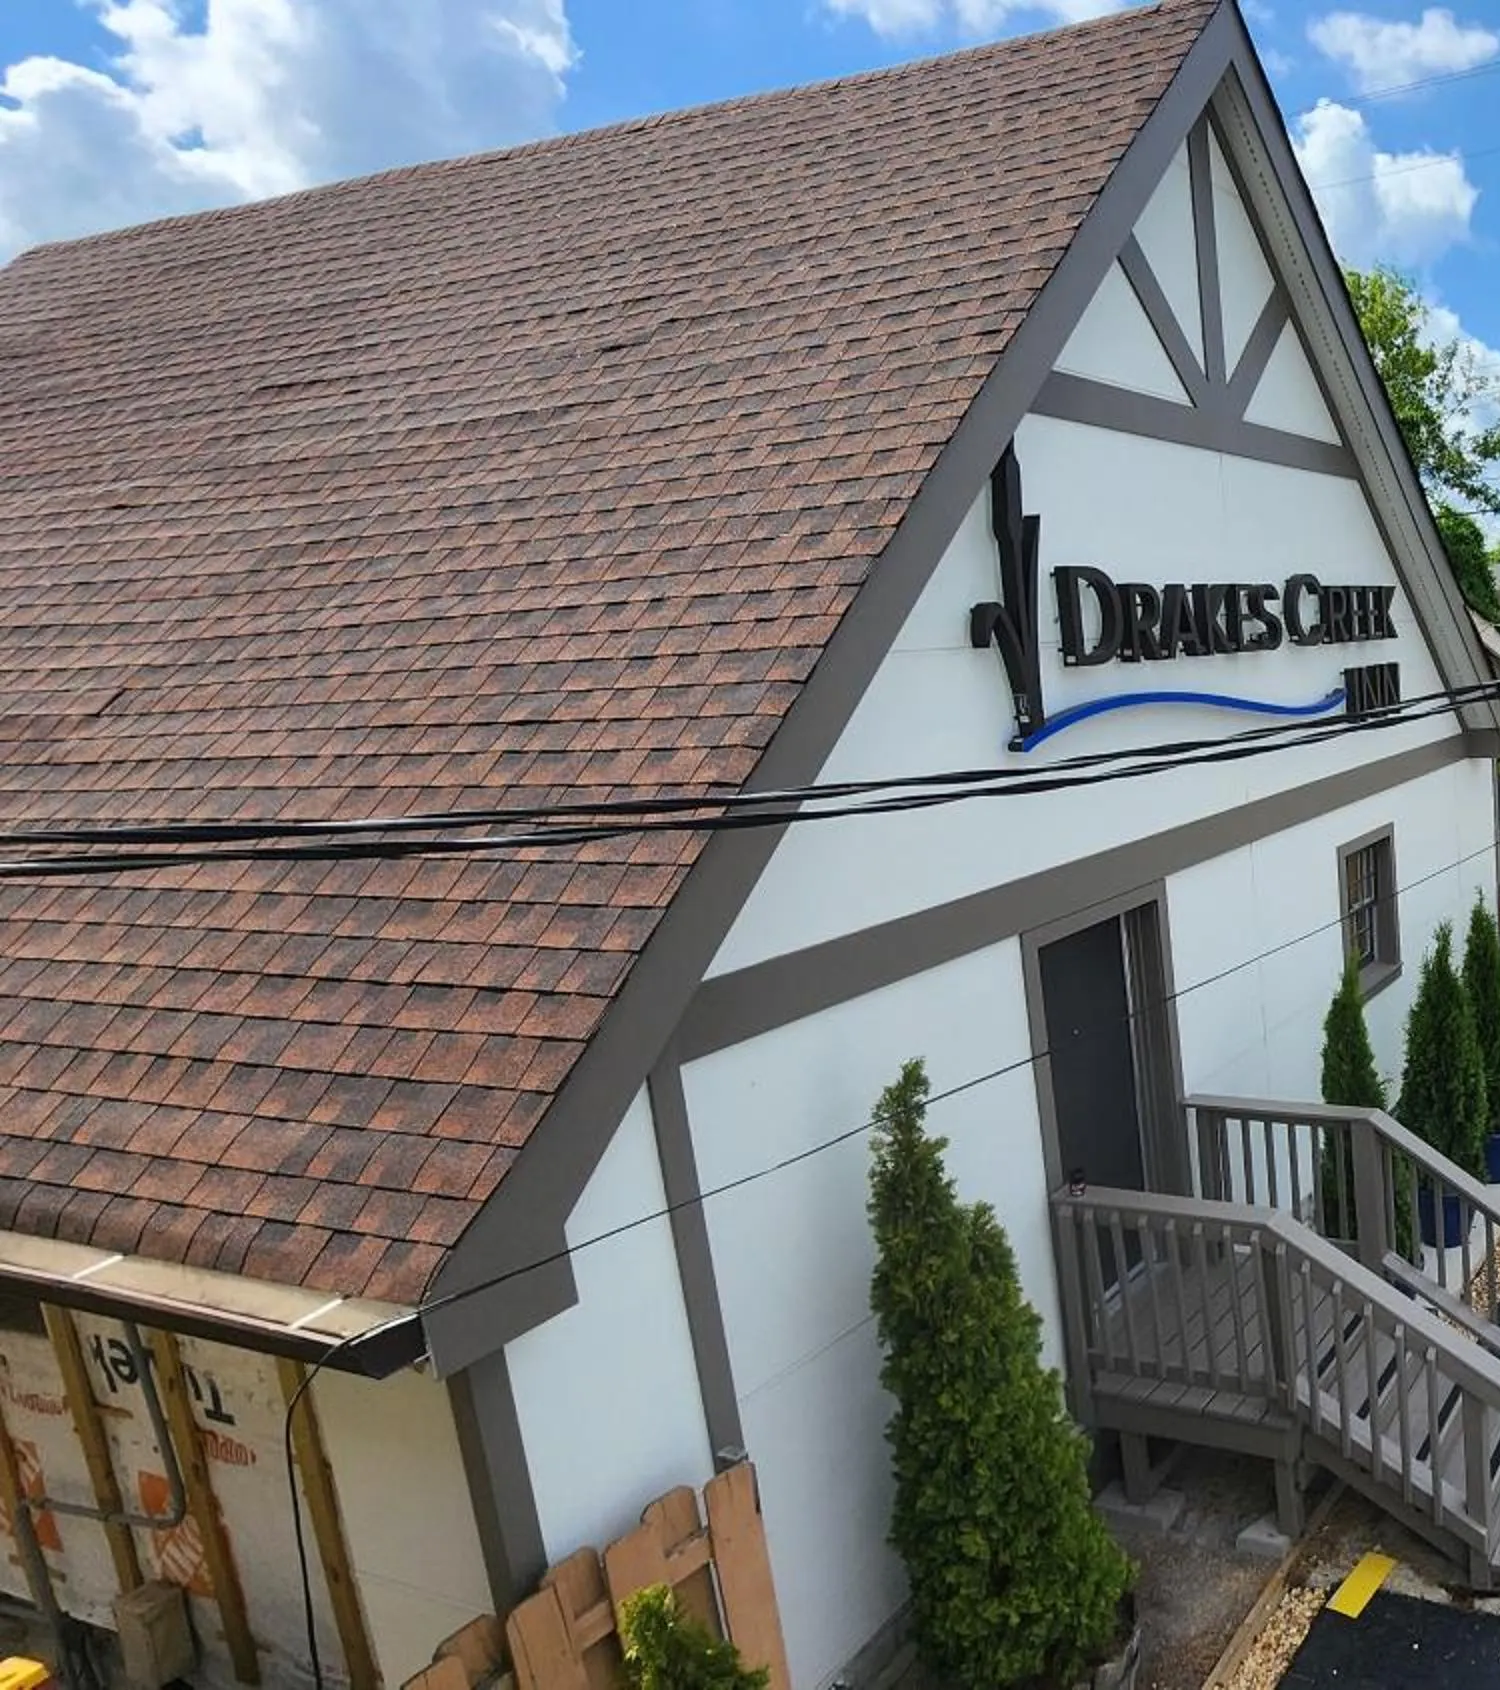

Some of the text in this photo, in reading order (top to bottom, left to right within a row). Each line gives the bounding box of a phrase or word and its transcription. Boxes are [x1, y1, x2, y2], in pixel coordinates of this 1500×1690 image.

[1052, 565, 1399, 667] DRAKES CREEK
[1344, 662, 1400, 724] INN
